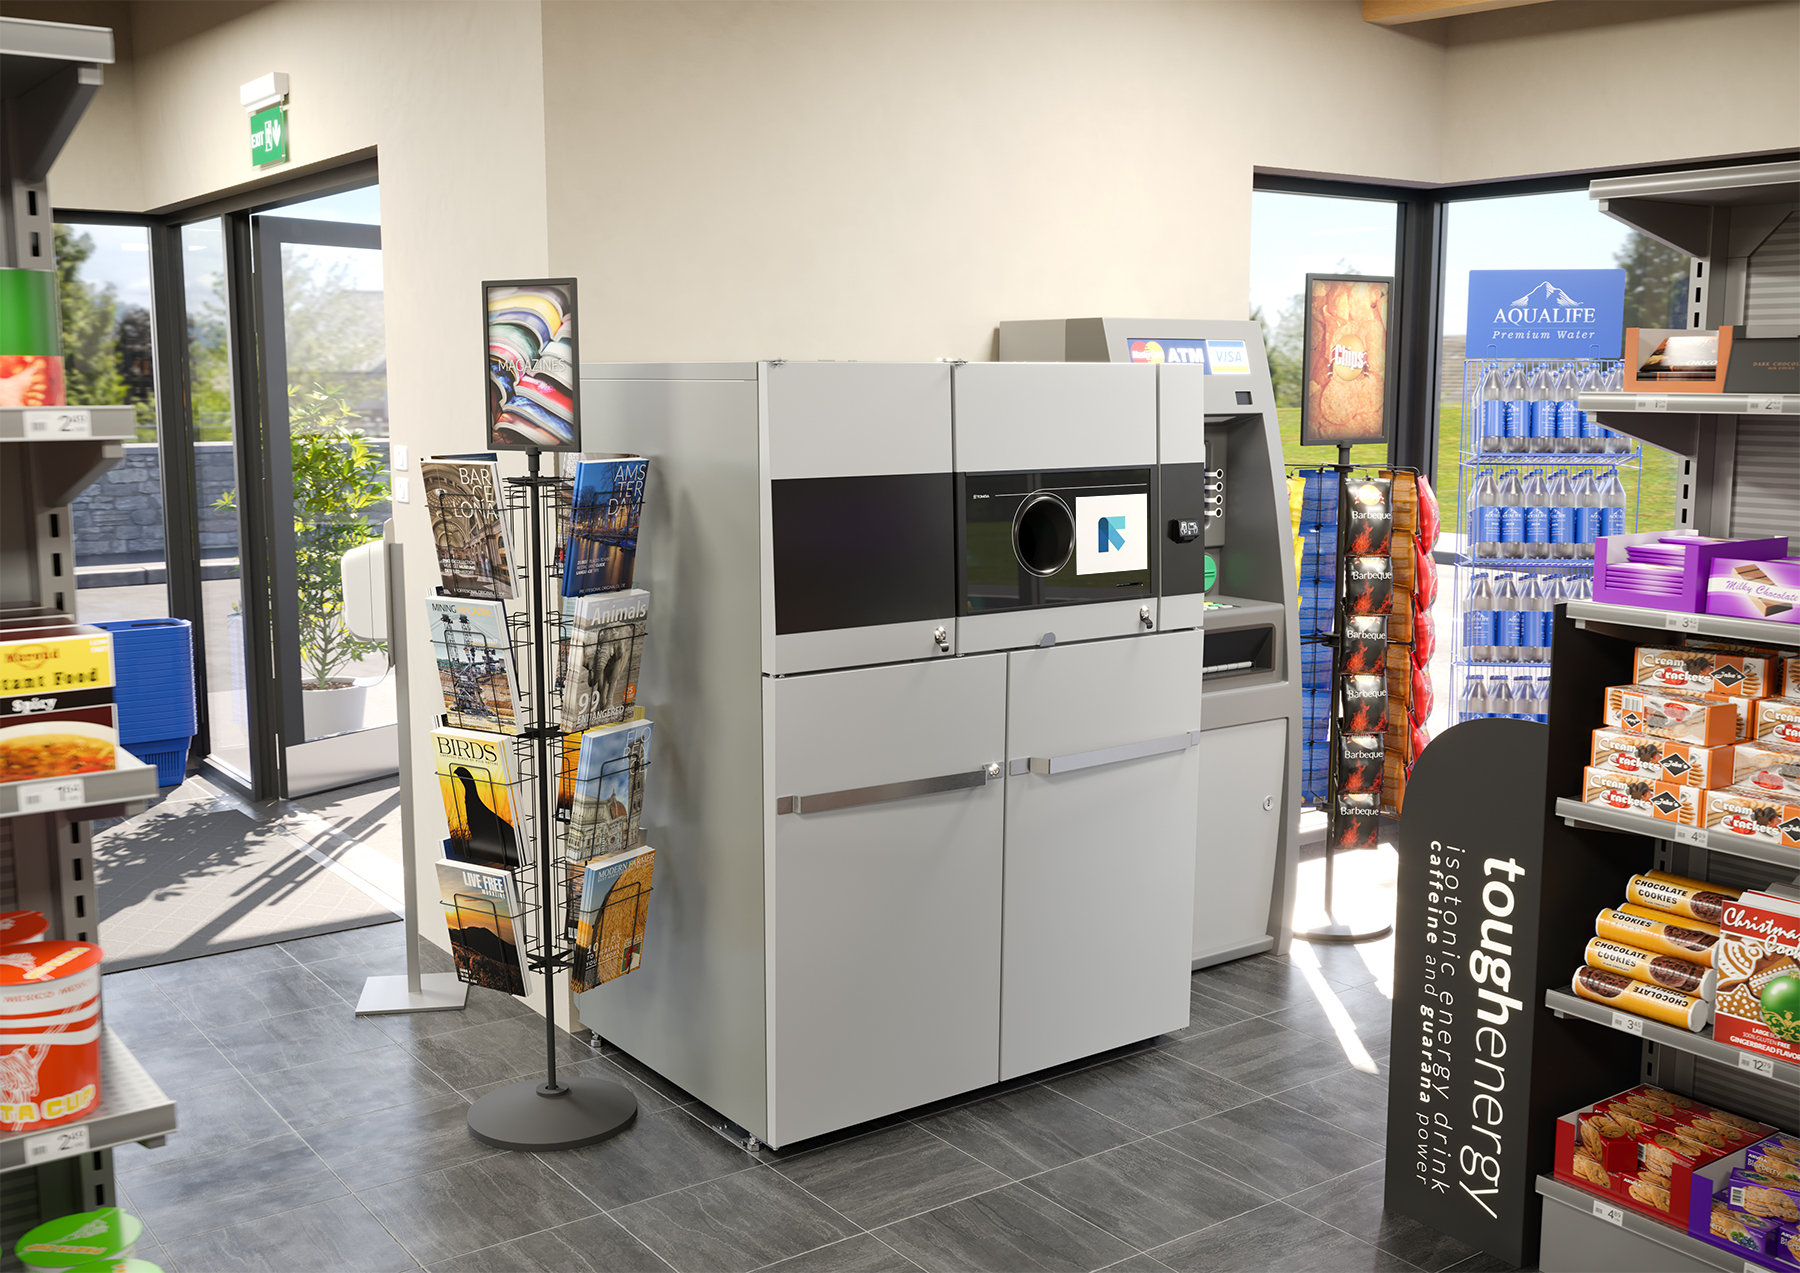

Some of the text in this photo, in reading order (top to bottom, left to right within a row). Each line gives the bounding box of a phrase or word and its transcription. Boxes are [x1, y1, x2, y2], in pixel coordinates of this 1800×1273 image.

[251, 130, 264, 149] EXIT
[1493, 308, 1596, 327] AQUALIFE
[1492, 330, 1595, 340] Premium Water
[1168, 347, 1205, 363] ATM
[1215, 350, 1243, 363] VISA
[1334, 343, 1365, 371] Chips
[498, 359, 566, 372] MAGAZINES
[459, 467, 492, 486] BAR
[614, 463, 647, 482] AMS
[472, 485, 494, 503] CE
[618, 480, 644, 498] TER
[452, 500, 499, 520] LONA
[607, 497, 641, 516] DAM
[1352, 511, 1391, 521] Barbeque
[1352, 570, 1392, 580] Barbeque
[1725, 580, 1799, 601] Milky Chocolate
[431, 603, 493, 618] MINING MAGAZINE
[591, 600, 646, 626] Animals
[1347, 630, 1386, 640] Barbeque
[1641, 654, 1685, 667] Cream
[53, 668, 99, 686] Food
[1652, 668, 1713, 683] Crackers
[578, 690, 600, 715] 99
[1347, 689, 1387, 699] Barbeque
[11, 697, 58, 714] Spicy
[626, 726, 652, 747] FLO
[1598, 737, 1637, 752] Cream
[437, 737, 497, 763] BIRDS
[1344, 750, 1384, 760] Barbeque
[1608, 753, 1661, 771] Crackers
[1590, 775, 1629, 790] Cream
[1599, 790, 1653, 809] Crackers
[1711, 798, 1755, 815] Cream
[1340, 807, 1379, 817] Barbeque
[1721, 815, 1781, 836] Crackers
[598, 861, 629, 878] MODERN
[628, 852, 655, 869] FARMER
[462, 871, 504, 893] LIVE FREE
[1634, 879, 1688, 897] CHOCOLATE
[1638, 889, 1677, 905] COOKIES
[1612, 913, 1653, 928] COOKIES
[1723, 907, 1800, 939] Christma
[586, 941, 599, 955] 10
[601, 933, 621, 950] TIPS
[1594, 940, 1648, 960] CHOCOLATE
[1597, 951, 1637, 968] COOKIES
[1632, 986, 1689, 1008] CHOCOLATE
[1415, 840, 1443, 1185] caffeine and guarana power
[1431, 844, 1466, 1194] isotonic energy drink
[1752, 1028, 1770, 1037] LARGE
[1730, 1035, 1776, 1053] GINGERBREAD
[1756, 1035, 1778, 1046] GLUTEN
[1777, 1041, 1791, 1050] FREE
[41, 1084, 96, 1119] CUP
[1747, 1158, 1781, 1177] Blueberry
